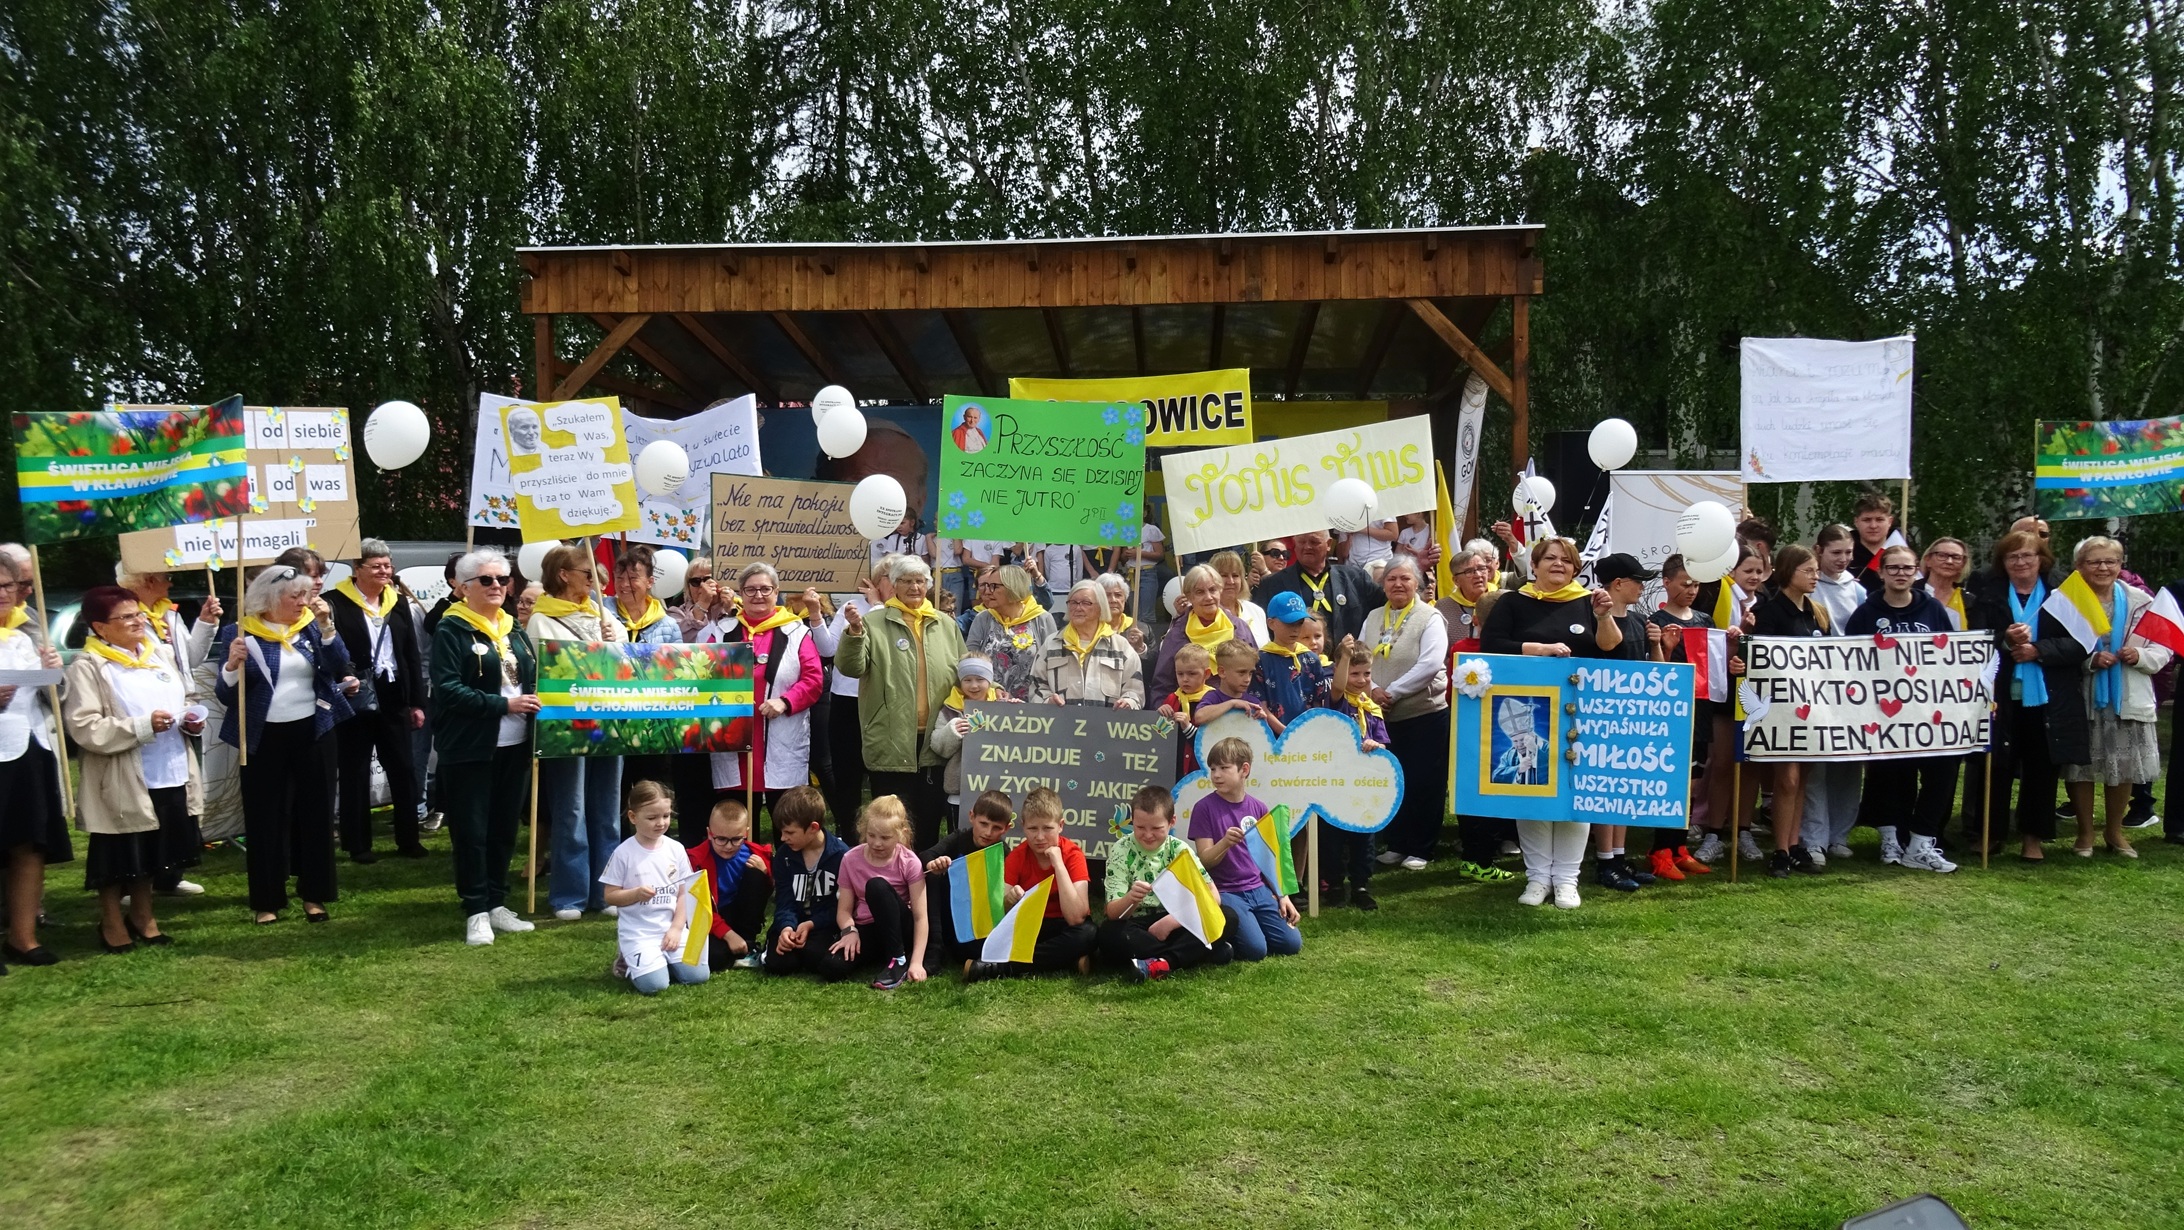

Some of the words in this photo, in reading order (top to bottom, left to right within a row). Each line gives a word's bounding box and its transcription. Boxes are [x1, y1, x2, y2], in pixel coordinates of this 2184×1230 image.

[1139, 391, 1245, 435] OWICE
[262, 423, 283, 438] od
[584, 431, 609, 441] Was,
[704, 424, 741, 446] świecie
[549, 453, 575, 462] teraz
[577, 451, 594, 462] Wy
[689, 444, 750, 478] yzwalało
[2062, 458, 2128, 470] ŚWIETLICA
[2129, 451, 2184, 468] WIEJSK
[48, 461, 139, 477] ŚWIETLICA
[960, 461, 1042, 481] ZACZYNA
[1052, 467, 1076, 484] SIĘ
[1085, 468, 1143, 496] DZISIAJ
[2095, 465, 2173, 482] PAWŁOWIE
[71, 479, 90, 492] W
[273, 475, 294, 491] od
[310, 480, 340, 490] was
[520, 474, 578, 489] przyszliście
[586, 471, 599, 481] do
[602, 469, 627, 479] mnie
[546, 494, 557, 503] za
[560, 492, 571, 501] to
[578, 488, 606, 498] Wam
[981, 489, 1008, 505] NIE
[757, 494, 783, 509] ma
[787, 491, 844, 520] pokoju
[720, 517, 745, 532] bez
[752, 517, 860, 541] sprawiedliwośc
[184, 536, 212, 552] nie
[716, 542, 739, 558] nie
[742, 545, 765, 558] ma
[716, 562, 738, 581] bez
[777, 567, 840, 583] aczenia.
[1751, 644, 1880, 672] BOGATYM
[1895, 639, 1937, 666] NIE
[1943, 639, 1995, 666] JEST
[569, 683, 641, 698] ŚWIETLICA
[642, 686, 700, 698] WIEJSKA
[1576, 666, 1680, 697] MIŁOŚĆ
[1811, 680, 1868, 706] KTO
[575, 701, 589, 712] W
[591, 700, 695, 712] CHOJNICZKACH
[1578, 698, 1671, 717] WSZYSTKO
[1673, 701, 1688, 717] CI
[984, 709, 1055, 734] KAŻDY
[1074, 719, 1087, 736] Z
[1106, 722, 1152, 741] WAS
[1575, 716, 1669, 739] WYJAŚNIŁA
[1745, 726, 1808, 751] ALE
[1878, 722, 1934, 749] KTO
[1941, 719, 1989, 746] DAE
[980, 744, 1081, 766] ZNAJDUJE
[1122, 748, 1159, 773] TEŻ
[1264, 752, 1307, 764] lękajcie
[1312, 751, 1333, 763] się!
[1572, 741, 1676, 773] MIŁOŚĆ
[967, 774, 990, 791] W
[1270, 776, 1328, 787] otwórzcie
[1354, 775, 1389, 787] oścież
[1574, 774, 1667, 796] WSZYSTKO
[1573, 795, 1684, 820] ROZWIĄZAŁA
[1062, 808, 1097, 827] OJE
[634, 952, 642, 967] 7
